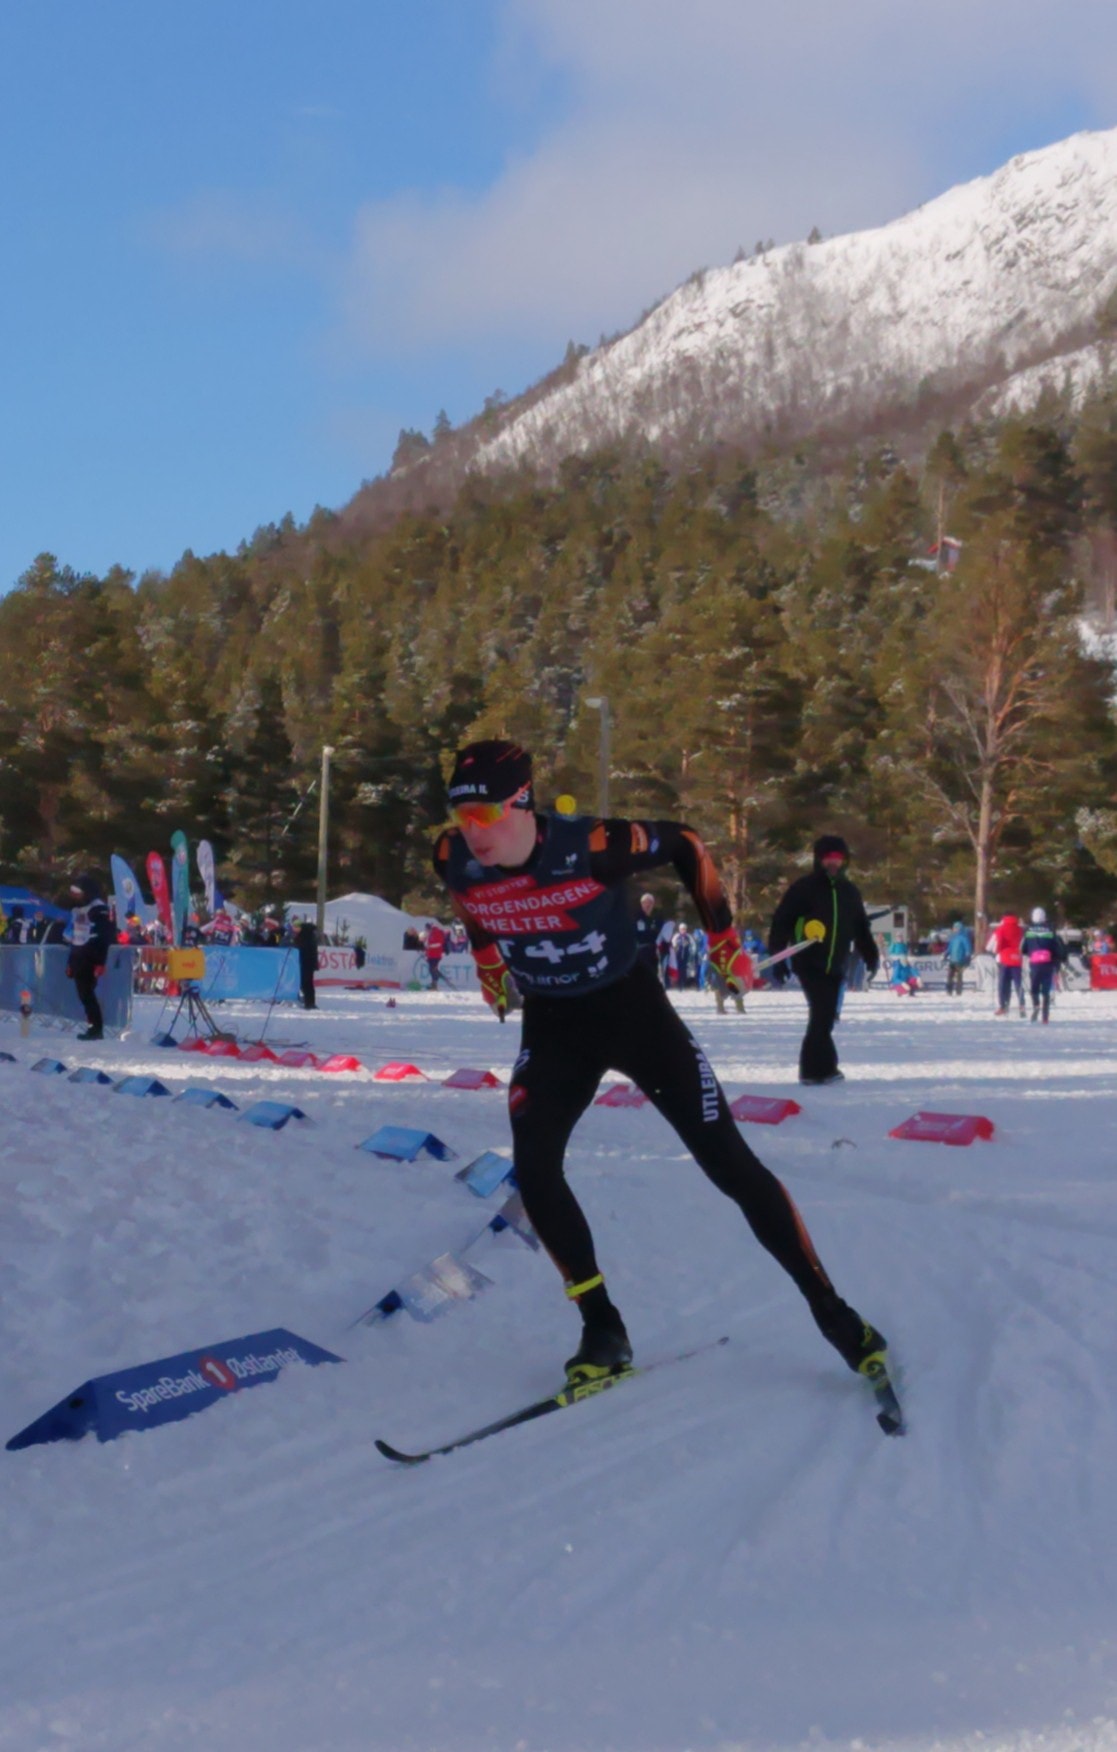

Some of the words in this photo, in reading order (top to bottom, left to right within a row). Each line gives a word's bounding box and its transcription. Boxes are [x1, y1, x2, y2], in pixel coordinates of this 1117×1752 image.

[463, 882, 600, 916] ORGENDAGENS
[482, 915, 562, 932] HELTER
[115, 1370, 211, 1413] SpareBank
[205, 1361, 227, 1383] 1
